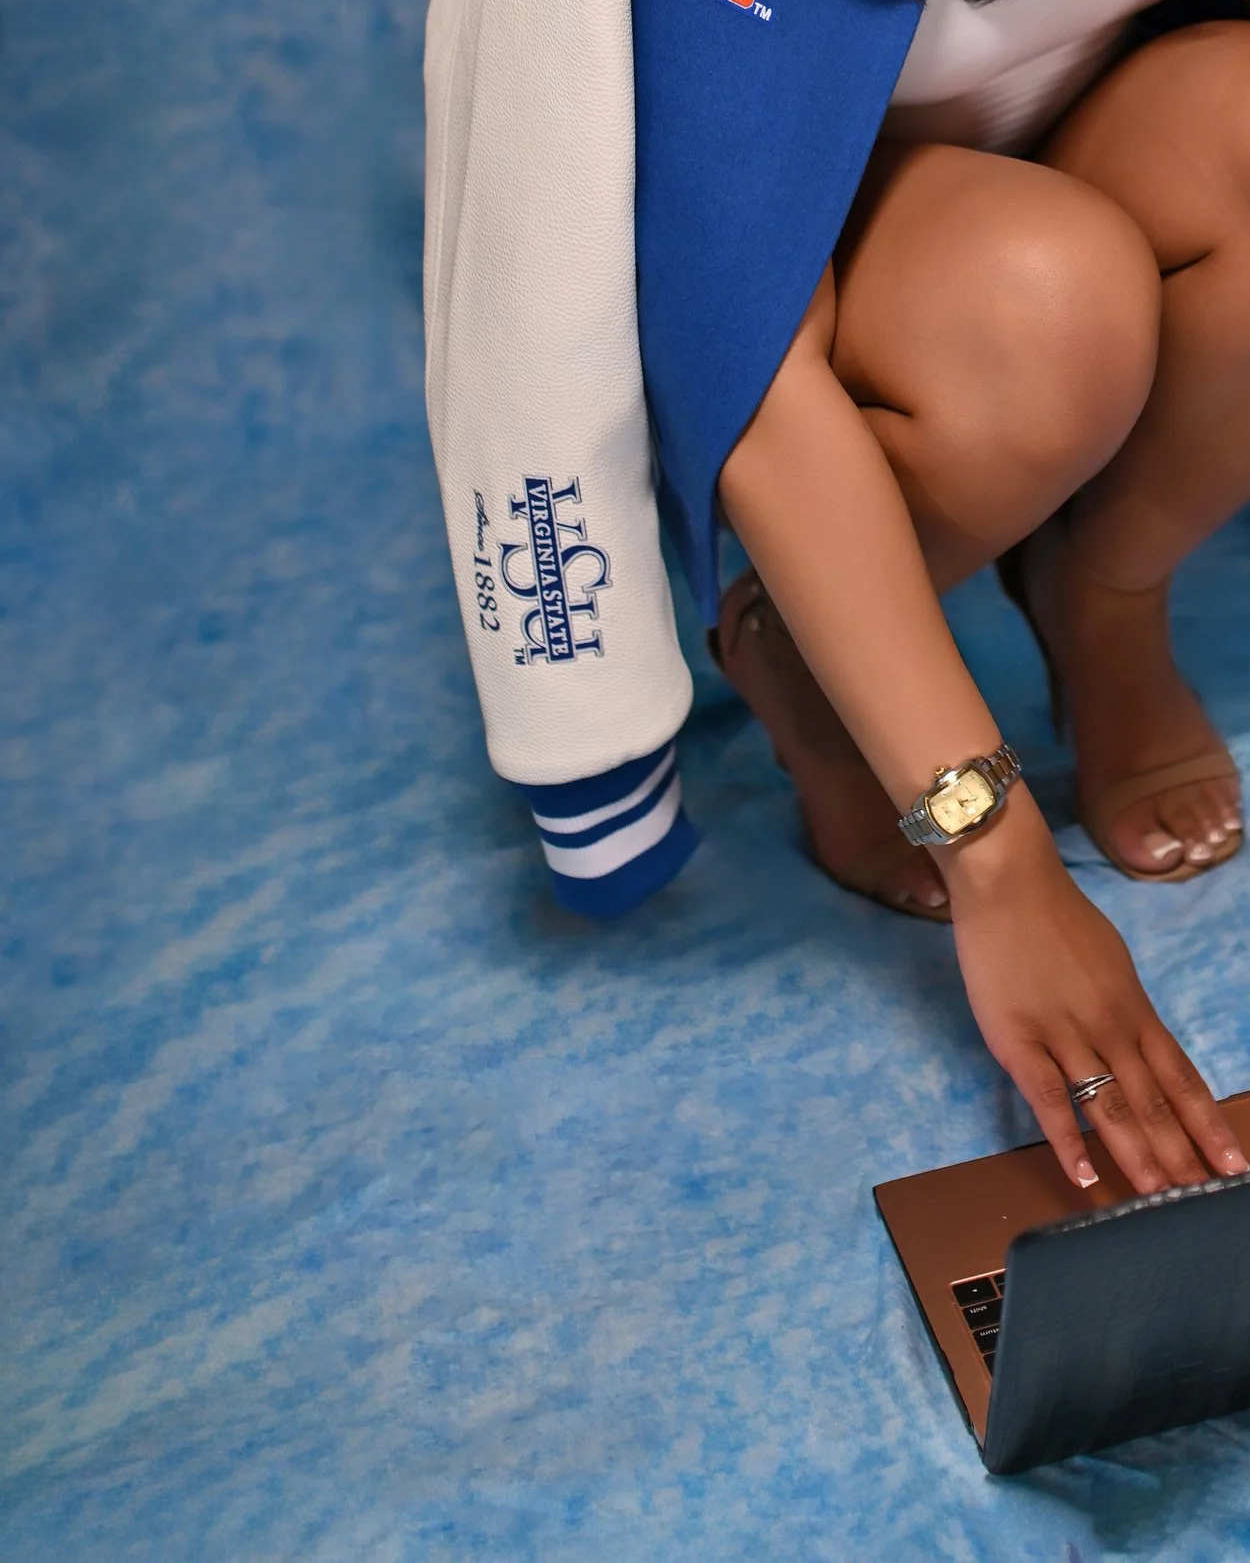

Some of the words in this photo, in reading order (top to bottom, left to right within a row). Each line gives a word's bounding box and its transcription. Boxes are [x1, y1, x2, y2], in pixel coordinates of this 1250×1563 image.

[473, 489, 490, 552] Since
[527, 483, 559, 586] VIRGINIA
[473, 552, 501, 633] 1882
[542, 590, 570, 657] STATE
[980, 1327, 1000, 1337] eturn
